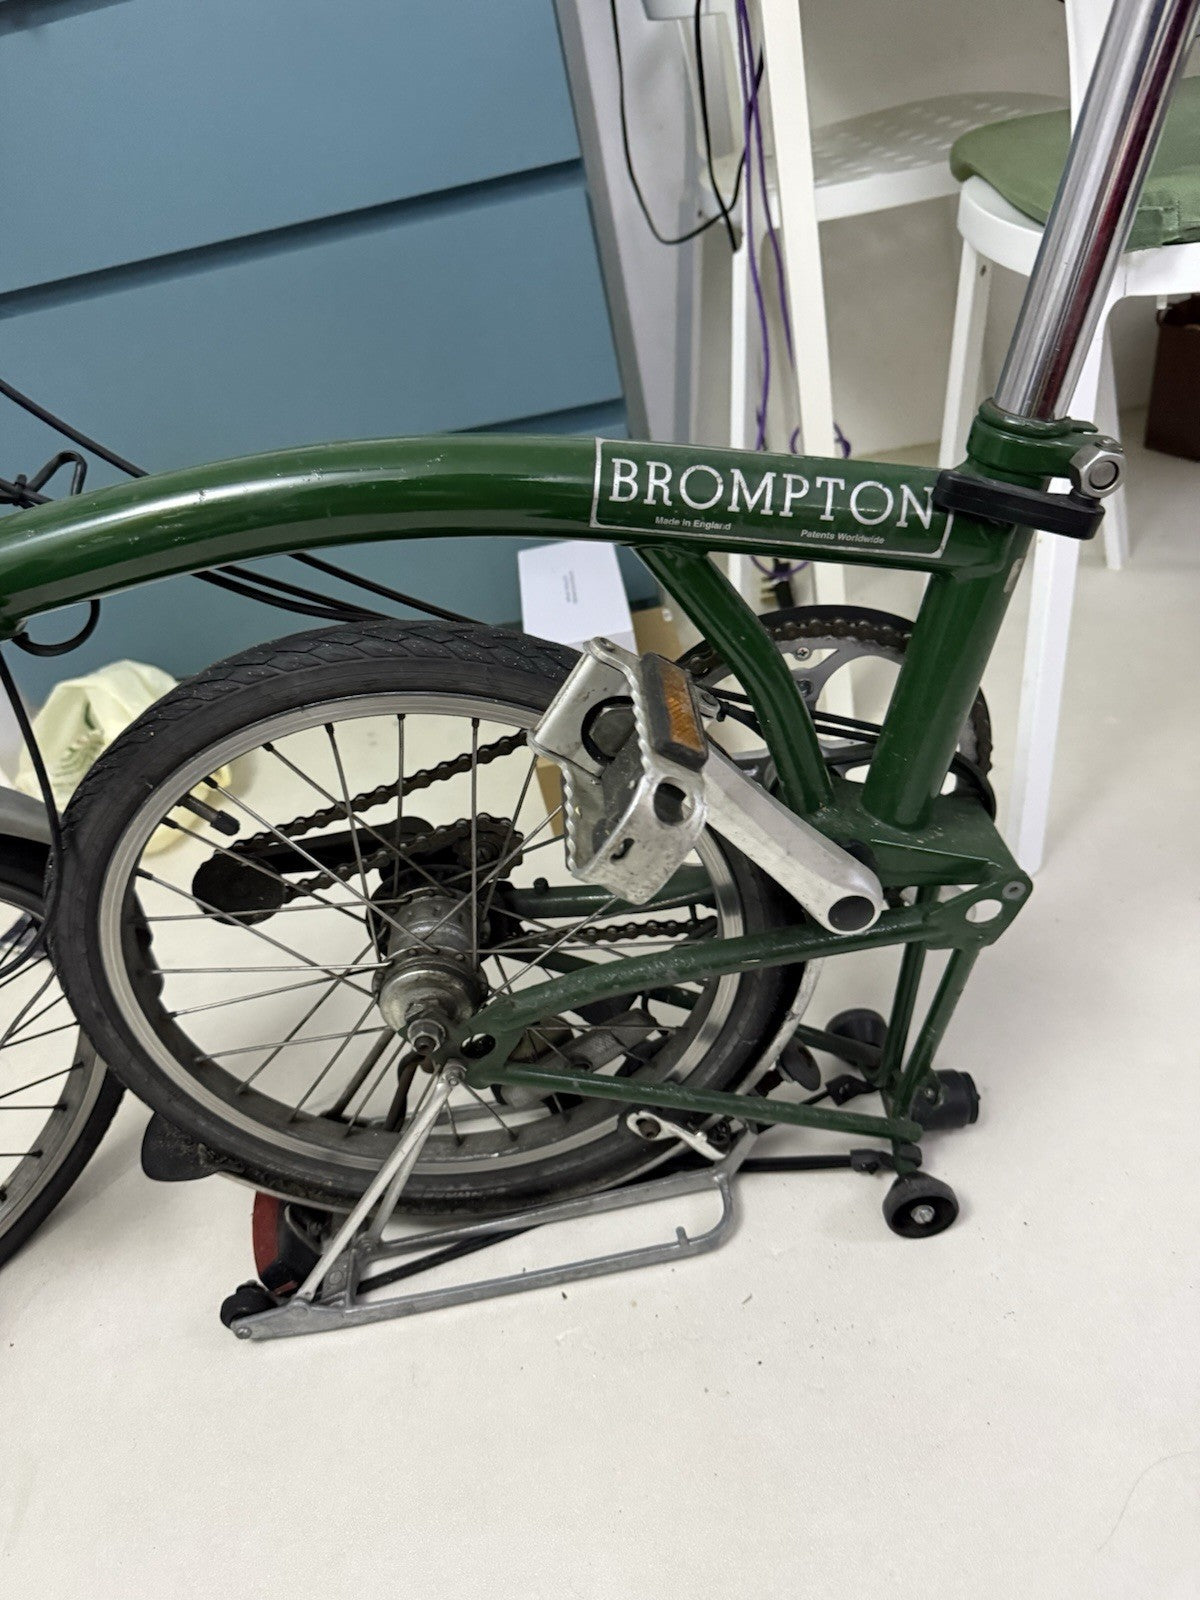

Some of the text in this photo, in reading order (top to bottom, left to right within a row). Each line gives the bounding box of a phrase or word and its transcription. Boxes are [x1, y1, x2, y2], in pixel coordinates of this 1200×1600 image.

[609, 458, 935, 530] BROMPTON
[655, 516, 680, 526] Made
[693, 519, 732, 531] England
[800, 529, 885, 544] Patents Worldwide
